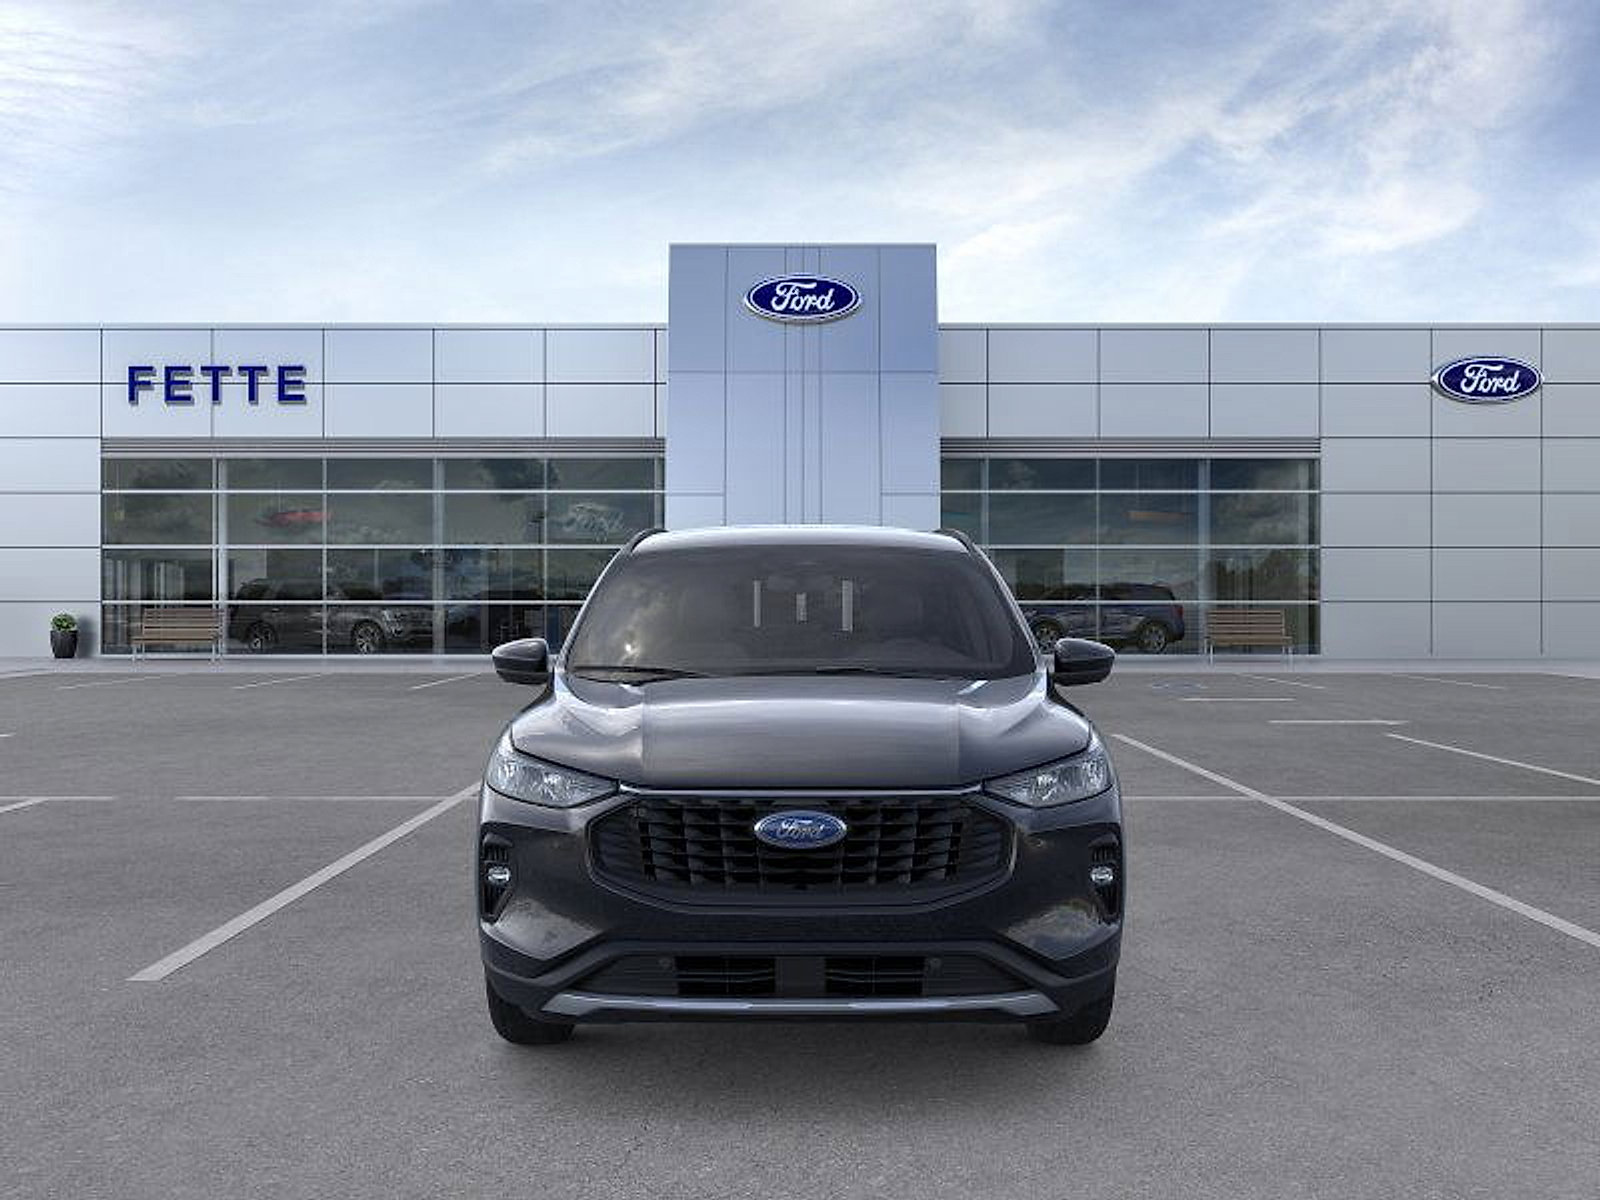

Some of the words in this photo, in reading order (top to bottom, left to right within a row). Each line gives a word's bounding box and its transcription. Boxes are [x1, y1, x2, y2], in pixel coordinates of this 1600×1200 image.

[771, 282, 835, 311] Ford
[128, 366, 306, 405] FETTE
[1461, 364, 1520, 393] Ford
[776, 819, 825, 839] Ford
